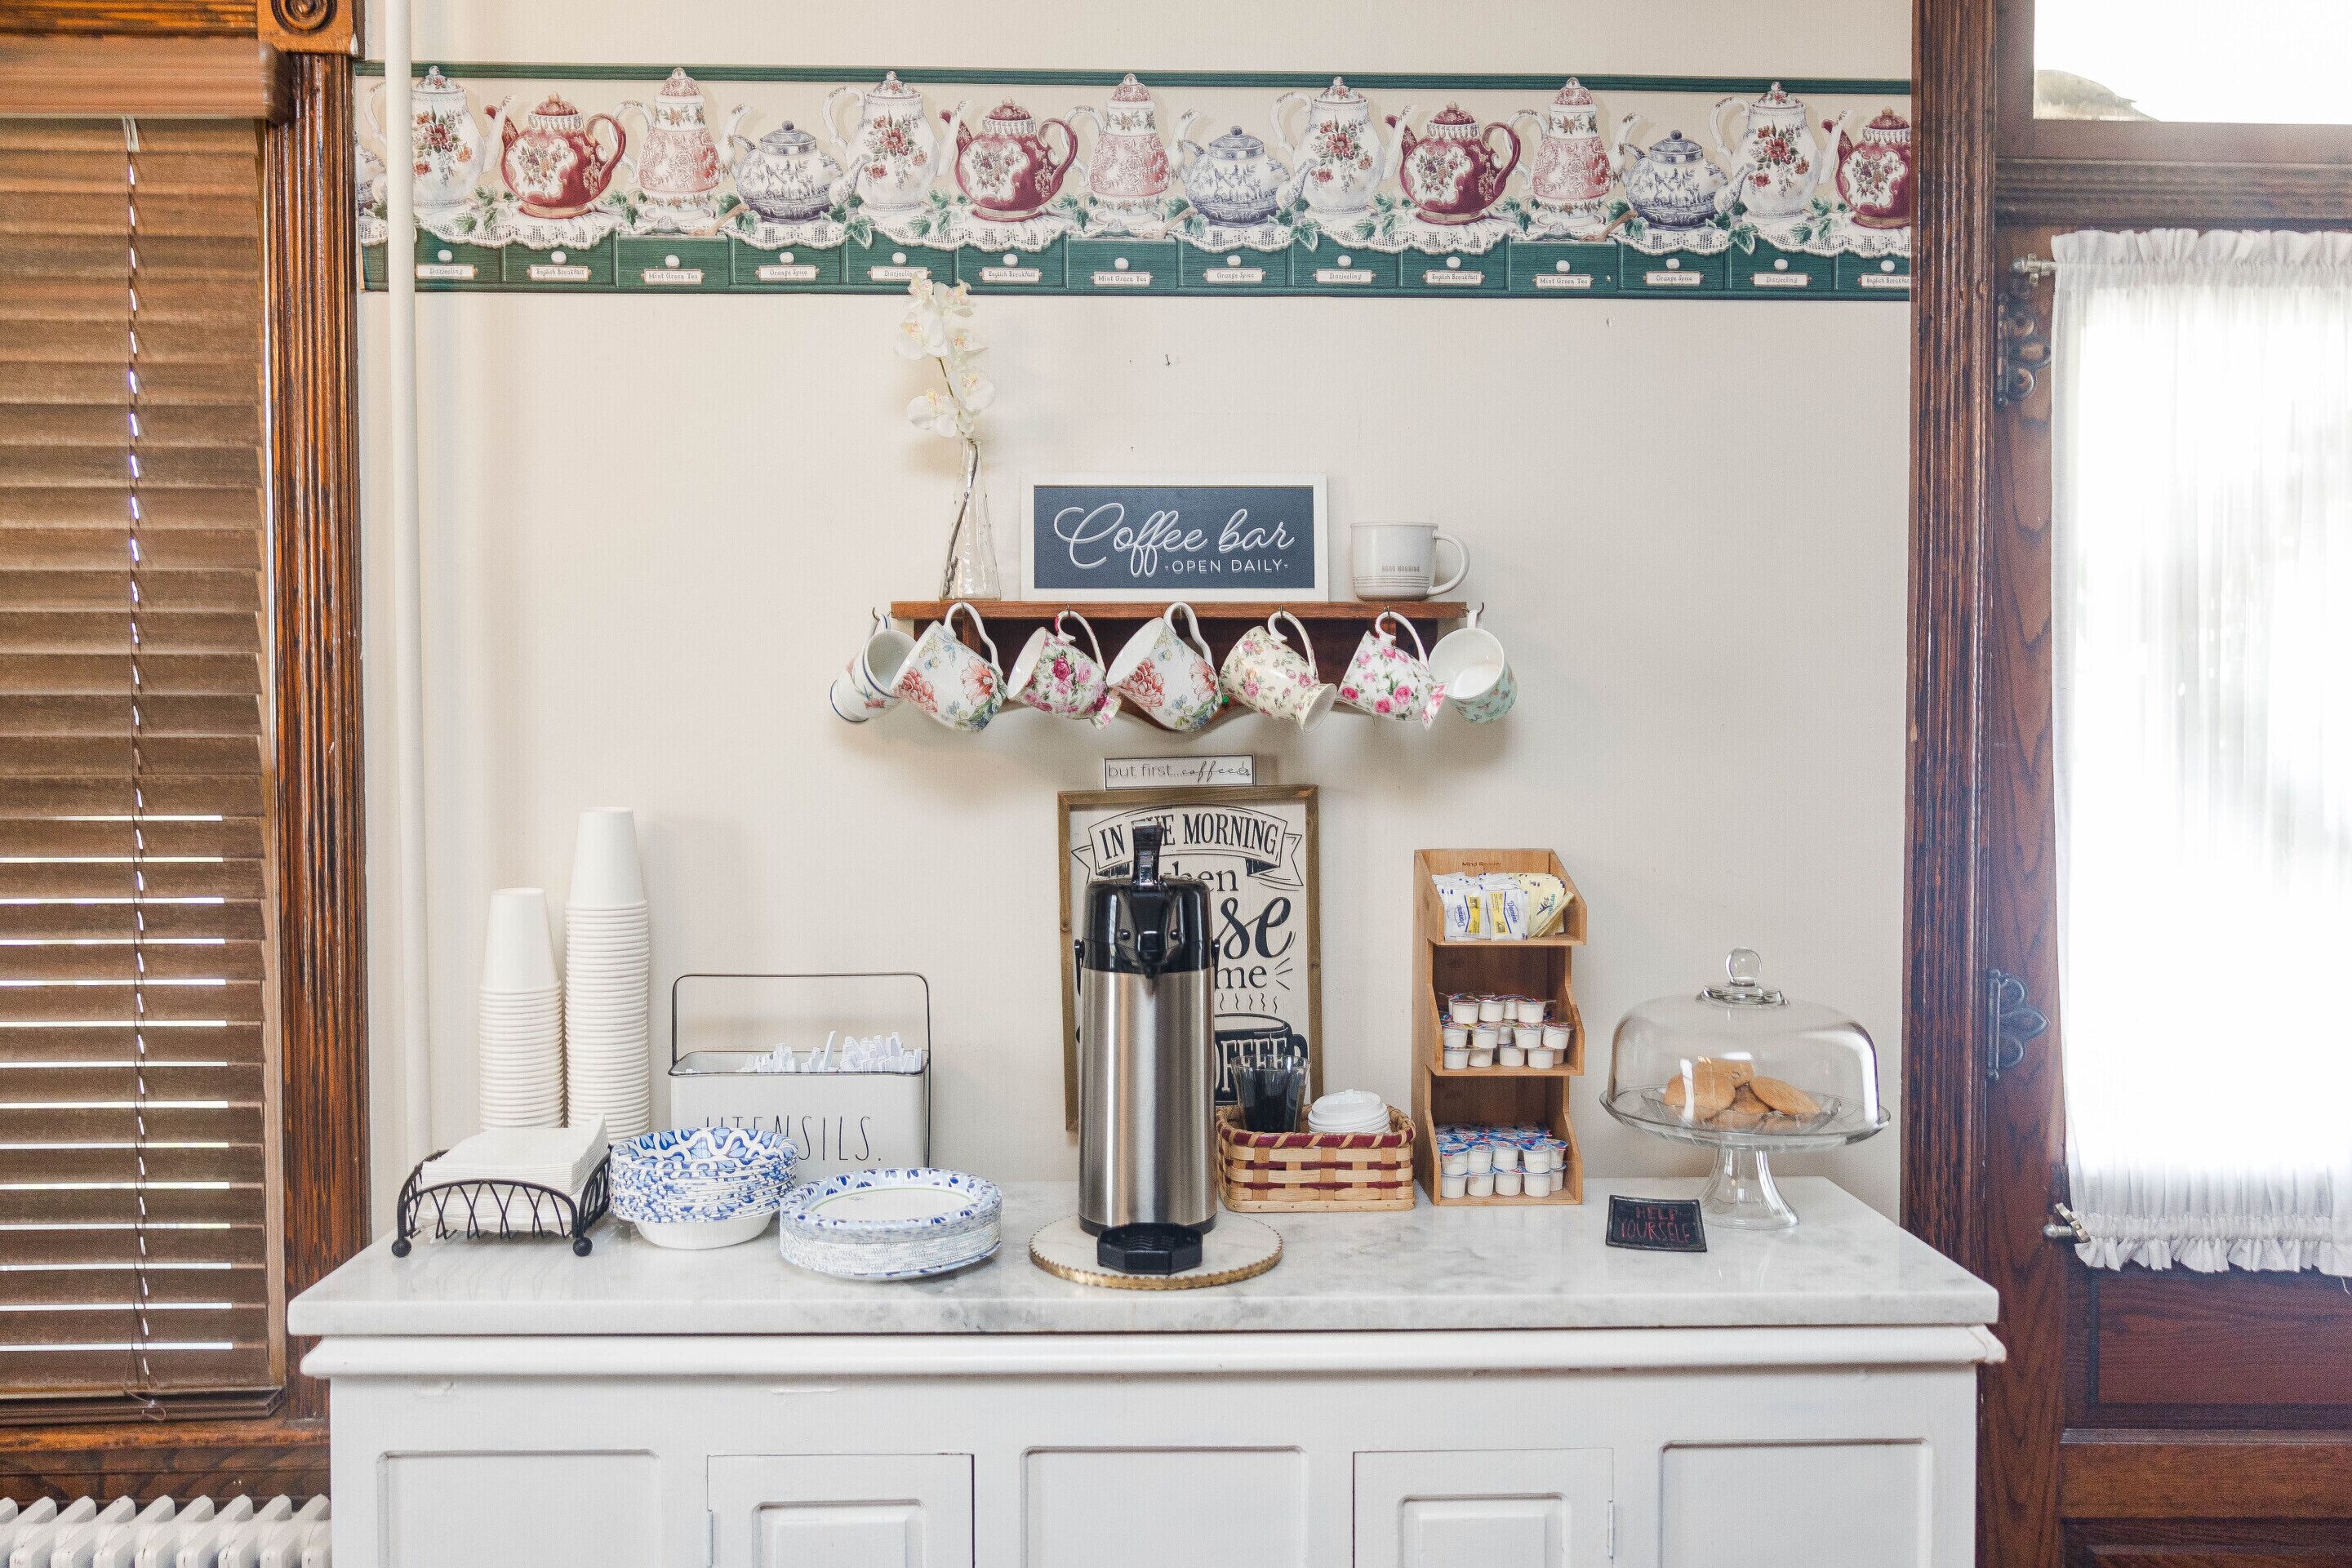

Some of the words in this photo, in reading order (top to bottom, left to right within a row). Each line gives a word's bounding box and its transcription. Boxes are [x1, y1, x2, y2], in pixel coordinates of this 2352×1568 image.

[536, 269, 556, 277] English
[770, 269, 791, 277] Orange
[792, 269, 807, 277] Spice
[989, 271, 1007, 279] English
[1216, 272, 1238, 280] Orange
[1432, 273, 1451, 282] English
[1866, 278, 1884, 286] English
[1054, 502, 1208, 578] Coffee
[1218, 508, 1295, 553] bar
[1108, 763, 1137, 779] but
[1099, 824, 1127, 860] IN
[1182, 813, 1279, 855] MORNING
